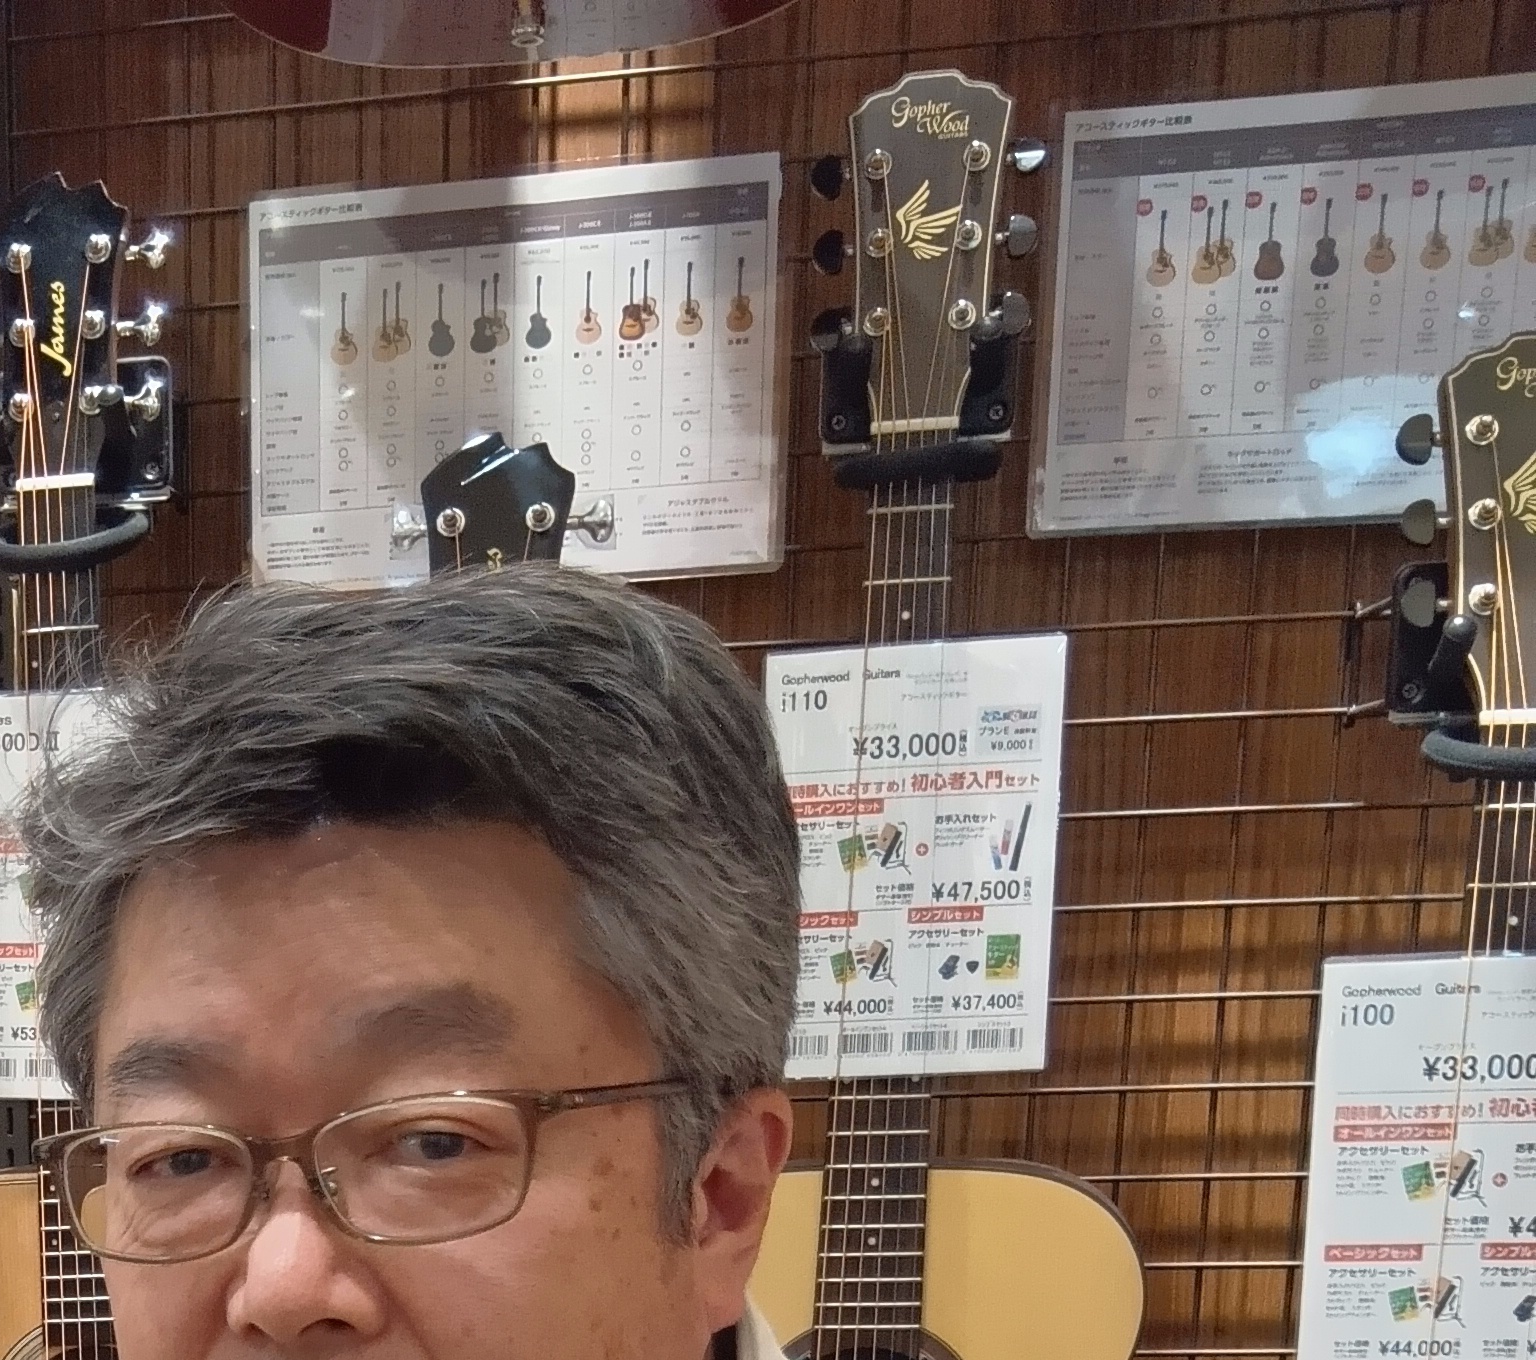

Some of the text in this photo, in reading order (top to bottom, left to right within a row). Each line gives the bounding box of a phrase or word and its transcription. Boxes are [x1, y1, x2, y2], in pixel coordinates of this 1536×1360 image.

[891, 96, 952, 128] Gopher
[917, 110, 970, 136] Wood
[40, 281, 72, 377] James
[1497, 357, 1536, 399] Gop
[781, 671, 850, 686] Gopherwood
[781, 689, 828, 713] i110
[853, 732, 956, 761] ¥33,000
[794, 802, 881, 814] ールインワンセット
[800, 822, 860, 832] セサリーセット
[935, 814, 996, 825] お手入れセット
[931, 879, 1020, 902] ¥47,500
[799, 915, 854, 926] シックセット
[911, 910, 981, 921] シンプルセット
[799, 934, 852, 944] サリーセット
[908, 928, 984, 939] アクセサリーセット
[1342, 984, 1422, 998] Gopherwood
[823, 998, 887, 1015] ¥44,000
[951, 993, 1016, 1011] ¥37,400
[1340, 1003, 1394, 1027] i100
[11, 1027, 37, 1041] ¥53
[1422, 1054, 1536, 1081] ¥33,000
[1335, 1098, 1536, 1121] 同時購入におすすめ!初心
[1337, 1146, 1430, 1156] アクセサリーセット
[1328, 1247, 1418, 1259] ベーシックセット
[1483, 1247, 1536, 1258] シンプル
[1328, 1268, 1416, 1278] アクセサリーセット
[1379, 1339, 1453, 1357] ¥44,000
